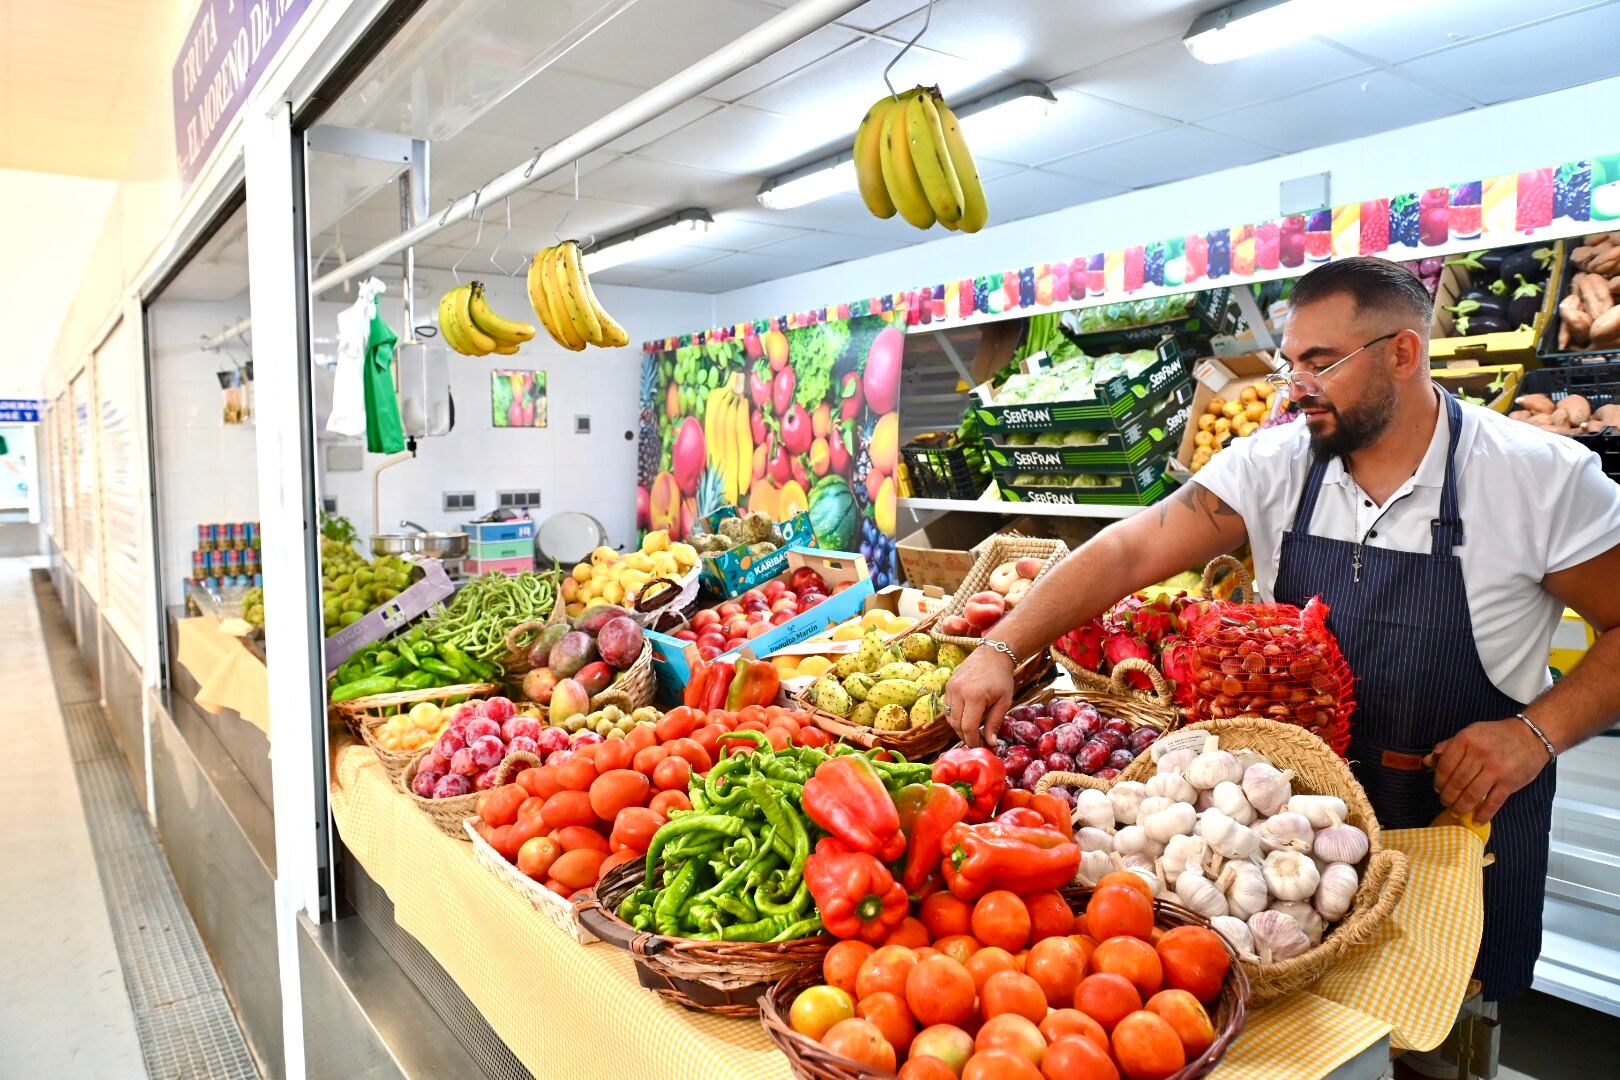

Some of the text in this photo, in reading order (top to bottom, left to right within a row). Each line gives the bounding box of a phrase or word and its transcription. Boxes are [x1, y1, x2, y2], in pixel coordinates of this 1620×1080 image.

[187, 0, 273, 166] EL MORENO DE
